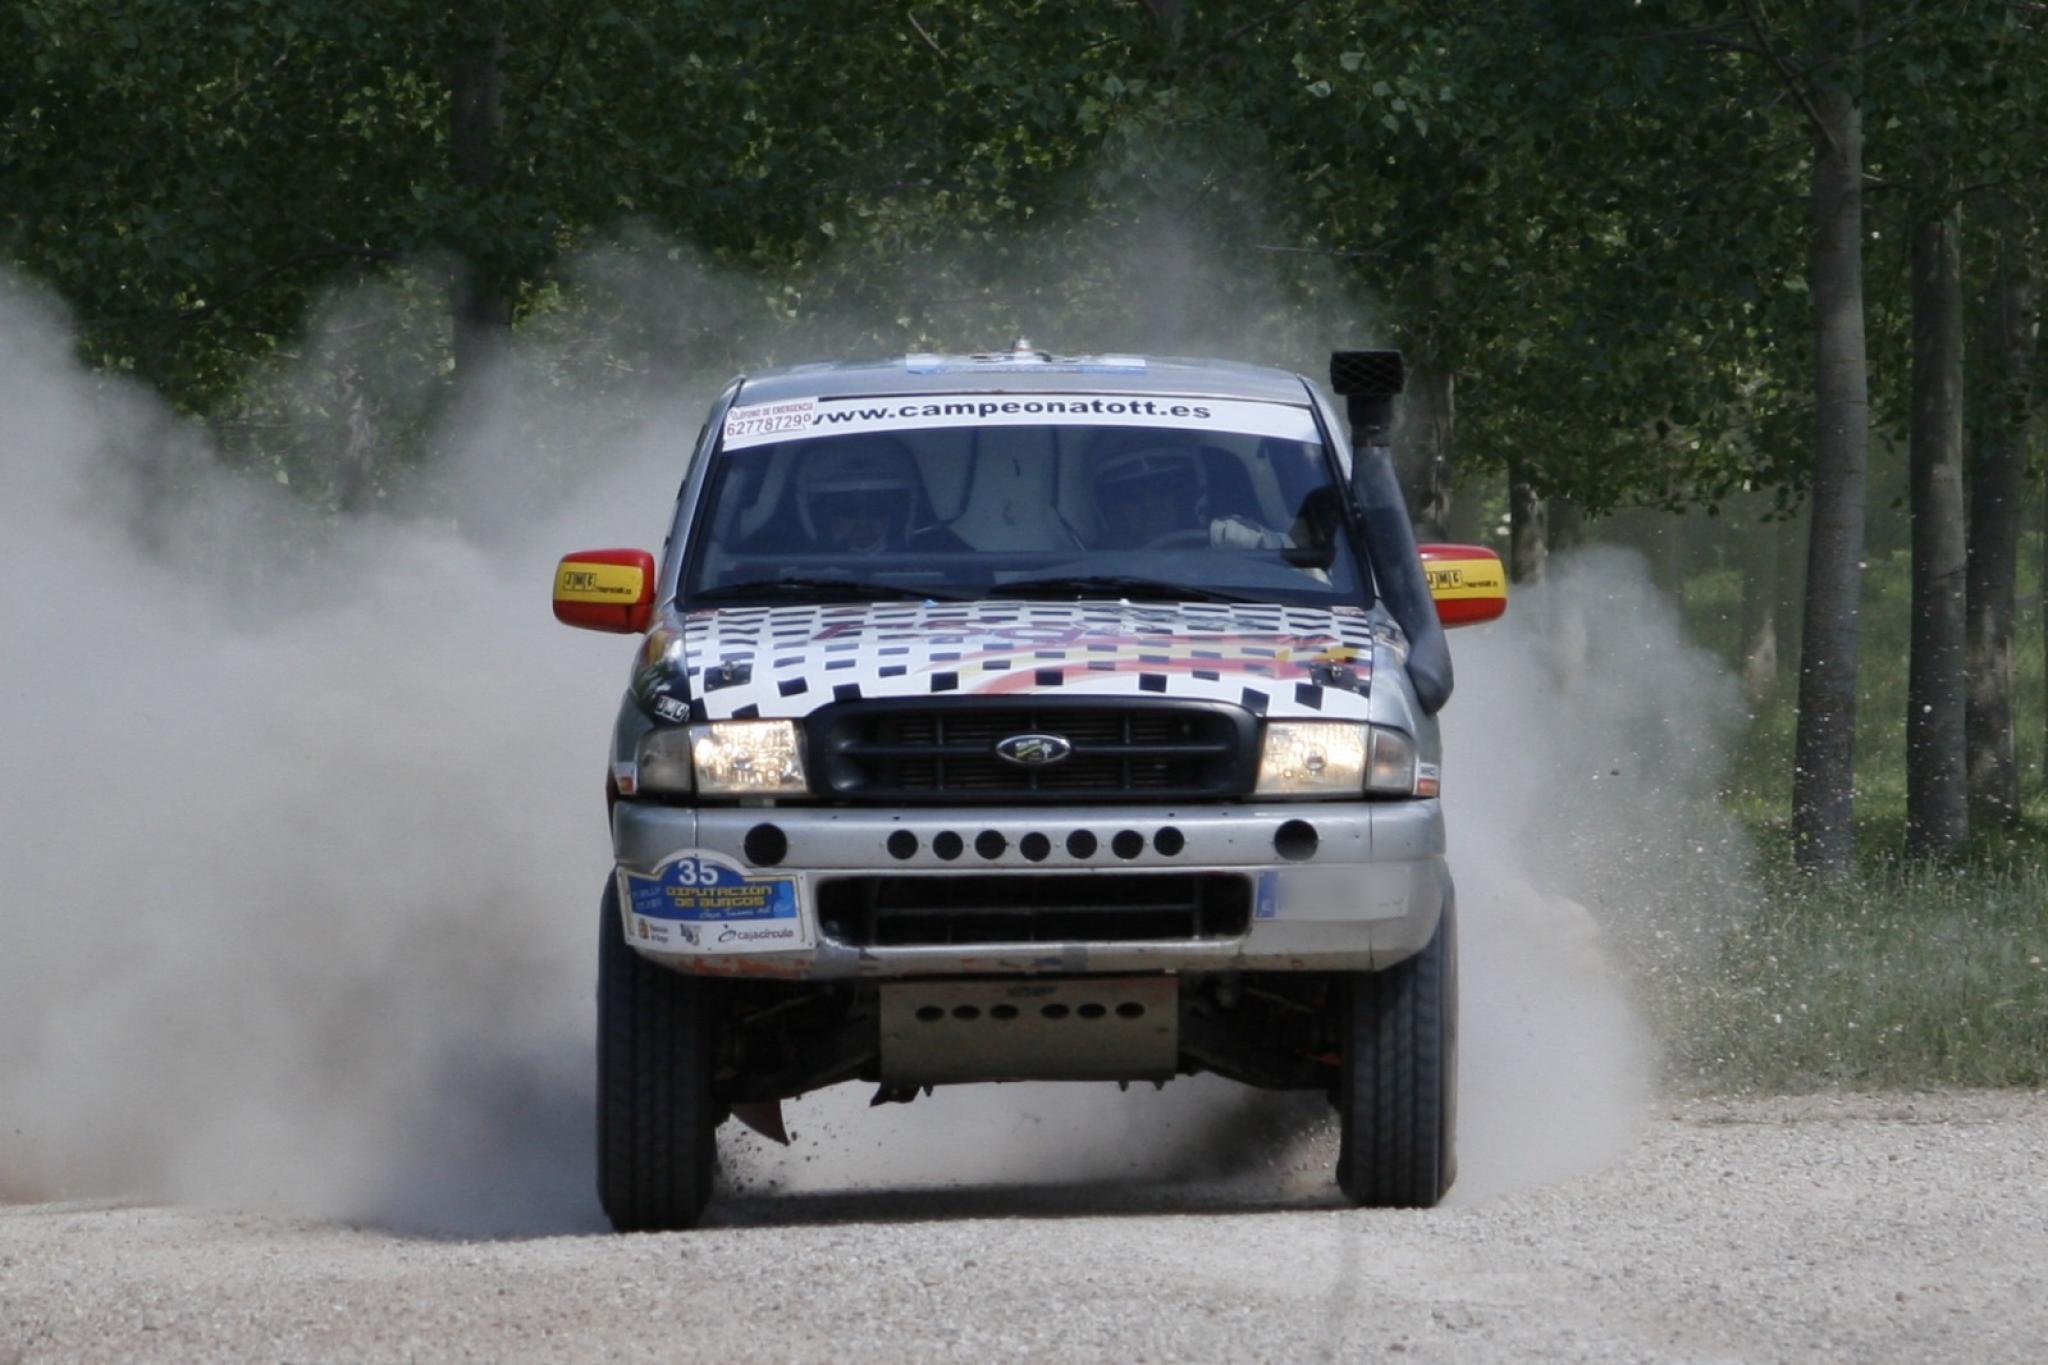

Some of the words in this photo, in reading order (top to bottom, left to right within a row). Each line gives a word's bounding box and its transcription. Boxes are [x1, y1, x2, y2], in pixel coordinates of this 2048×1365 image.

[678, 861, 718, 885] 35
[675, 897, 695, 907] DE
[699, 896, 765, 908] BURGOS
